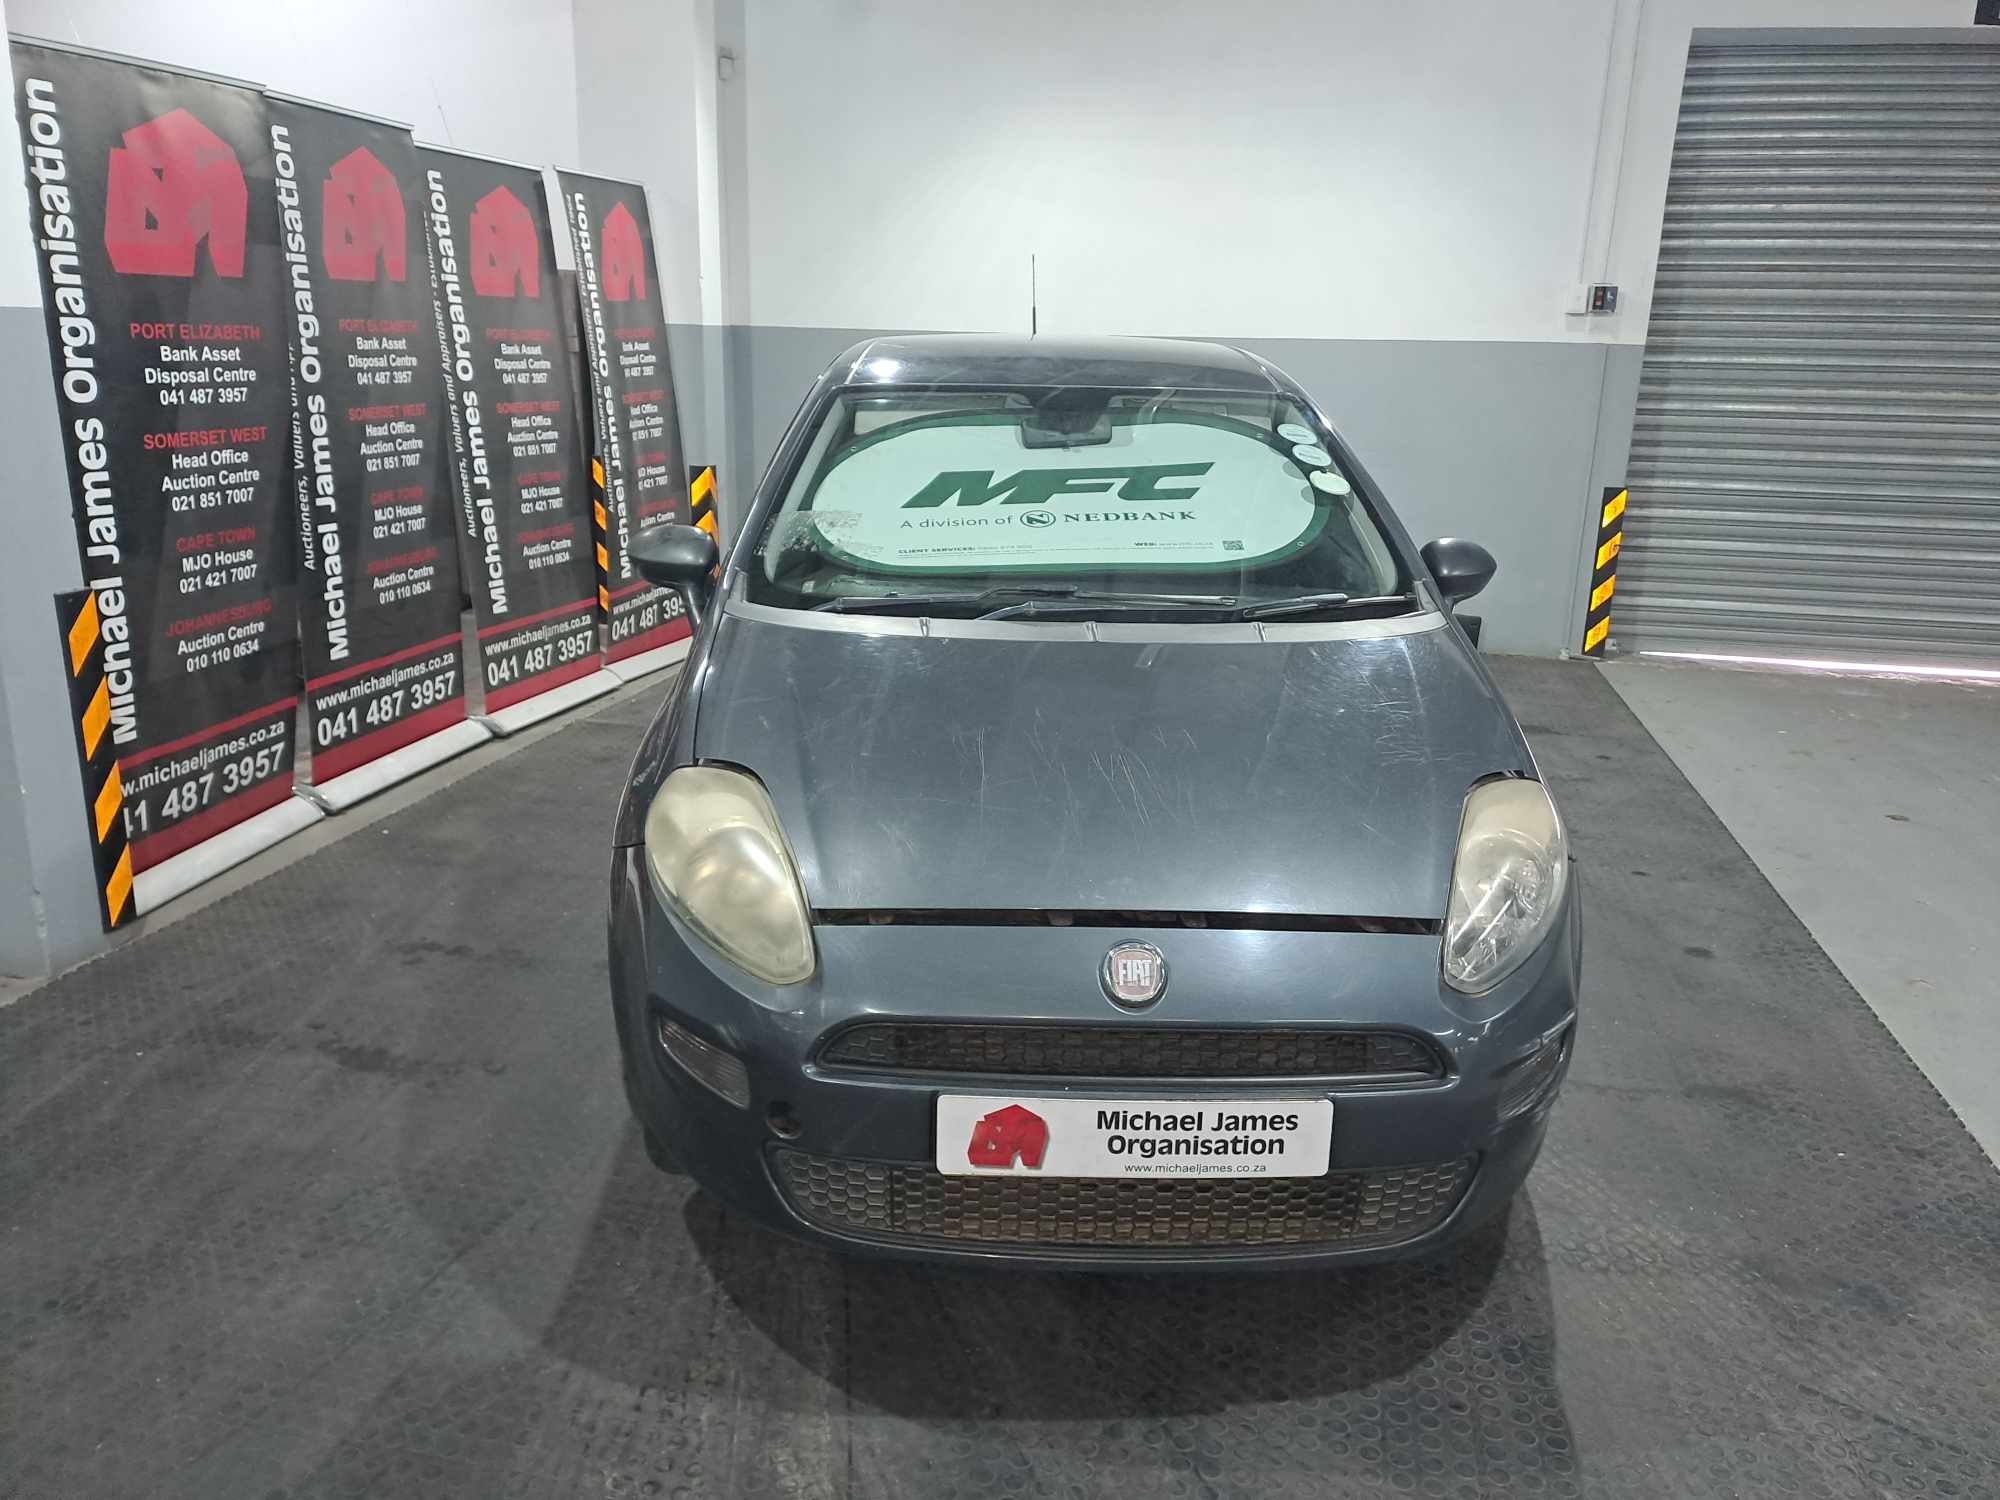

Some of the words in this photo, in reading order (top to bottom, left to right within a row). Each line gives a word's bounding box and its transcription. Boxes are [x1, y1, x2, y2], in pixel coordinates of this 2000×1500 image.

[25, 78, 98, 404] Organisation
[271, 124, 322, 383] Organisation
[427, 169, 474, 382] Organisation
[574, 192, 609, 378] Organisation
[130, 323, 175, 339] PORT
[180, 324, 261, 341] ELIZABETH
[356, 336, 379, 350] Bank
[381, 337, 407, 350] Asset
[160, 346, 198, 361] Bank
[202, 346, 241, 361] Asset
[348, 355, 388, 370] Disposal
[389, 354, 418, 367] Centre
[144, 368, 209, 387] Disposal
[213, 366, 257, 382] Centre
[357, 371, 373, 385] 041
[374, 371, 390, 384] 487
[393, 370, 412, 384] 3957
[445, 378, 455, 401] and
[160, 389, 184, 405] 041
[190, 388, 213, 404] 487
[218, 387, 248, 403] 3957
[144, 430, 227, 449] SOMERSET
[230, 426, 267, 443] WEST
[365, 423, 388, 437] Head
[389, 421, 416, 434] Office
[448, 403, 463, 454] Valuers
[462, 390, 491, 490] James
[603, 385, 621, 472] James
[172, 452, 207, 469] Head
[211, 449, 249, 465] Office
[307, 393, 336, 512] James
[360, 441, 394, 456] Auction
[396, 438, 423, 451] Centre
[366, 458, 382, 472] 021
[384, 456, 399, 470] 851
[401, 453, 421, 467] 7007
[74, 417, 121, 564] James
[162, 474, 215, 492] Auction
[219, 468, 260, 485] Centre
[899, 461, 1216, 509] MFC
[172, 495, 196, 512] 021
[200, 491, 222, 508] 851
[226, 487, 254, 504] 7007
[459, 458, 476, 537] Auctioneers,
[297, 475, 316, 570] Auctioneers,
[374, 507, 394, 522] MJO
[395, 504, 423, 518] House
[900, 519, 915, 530] A
[919, 515, 989, 529] division
[993, 513, 1013, 527] of
[1063, 511, 1198, 523] NEDBANK
[373, 525, 388, 539] 021
[390, 521, 405, 535] 421
[406, 517, 426, 532] 7007
[613, 478, 632, 579] Michael
[182, 553, 211, 573] MJO
[215, 548, 254, 566] House
[477, 497, 508, 615] Michael
[179, 577, 201, 594] 021
[205, 571, 227, 587] 421
[231, 564, 258, 582] 7007
[373, 572, 406, 590] Auction
[407, 565, 435, 581] Centre
[317, 523, 349, 661] Michael
[379, 589, 395, 605] 010
[397, 585, 411, 599] 110
[412, 580, 431, 595] 0634
[612, 614, 635, 640] 041
[639, 603, 658, 629] 487
[177, 632, 225, 655] Auction
[228, 621, 265, 641] Centre
[90, 577, 137, 745] Michael
[186, 654, 208, 672] 010
[211, 647, 230, 665] 110
[233, 638, 260, 658] 0634
[487, 658, 518, 687] 041
[523, 643, 553, 675] 487
[557, 630, 593, 662] 3957
[316, 651, 455, 711] www.michaeljames.co.za
[316, 708, 358, 746] 041
[366, 690, 405, 725] 487
[410, 671, 456, 710] 3957
[161, 772, 214, 820] 487
[222, 741, 285, 794] 3957
[1118, 959, 1152, 986] FIAT
[1097, 1110, 1203, 1131] Michael
[1211, 1112, 1298, 1132] James
[1107, 1134, 1285, 1158] Organisation
[1124, 1163, 1267, 1175] www.michaeljames.co.za
